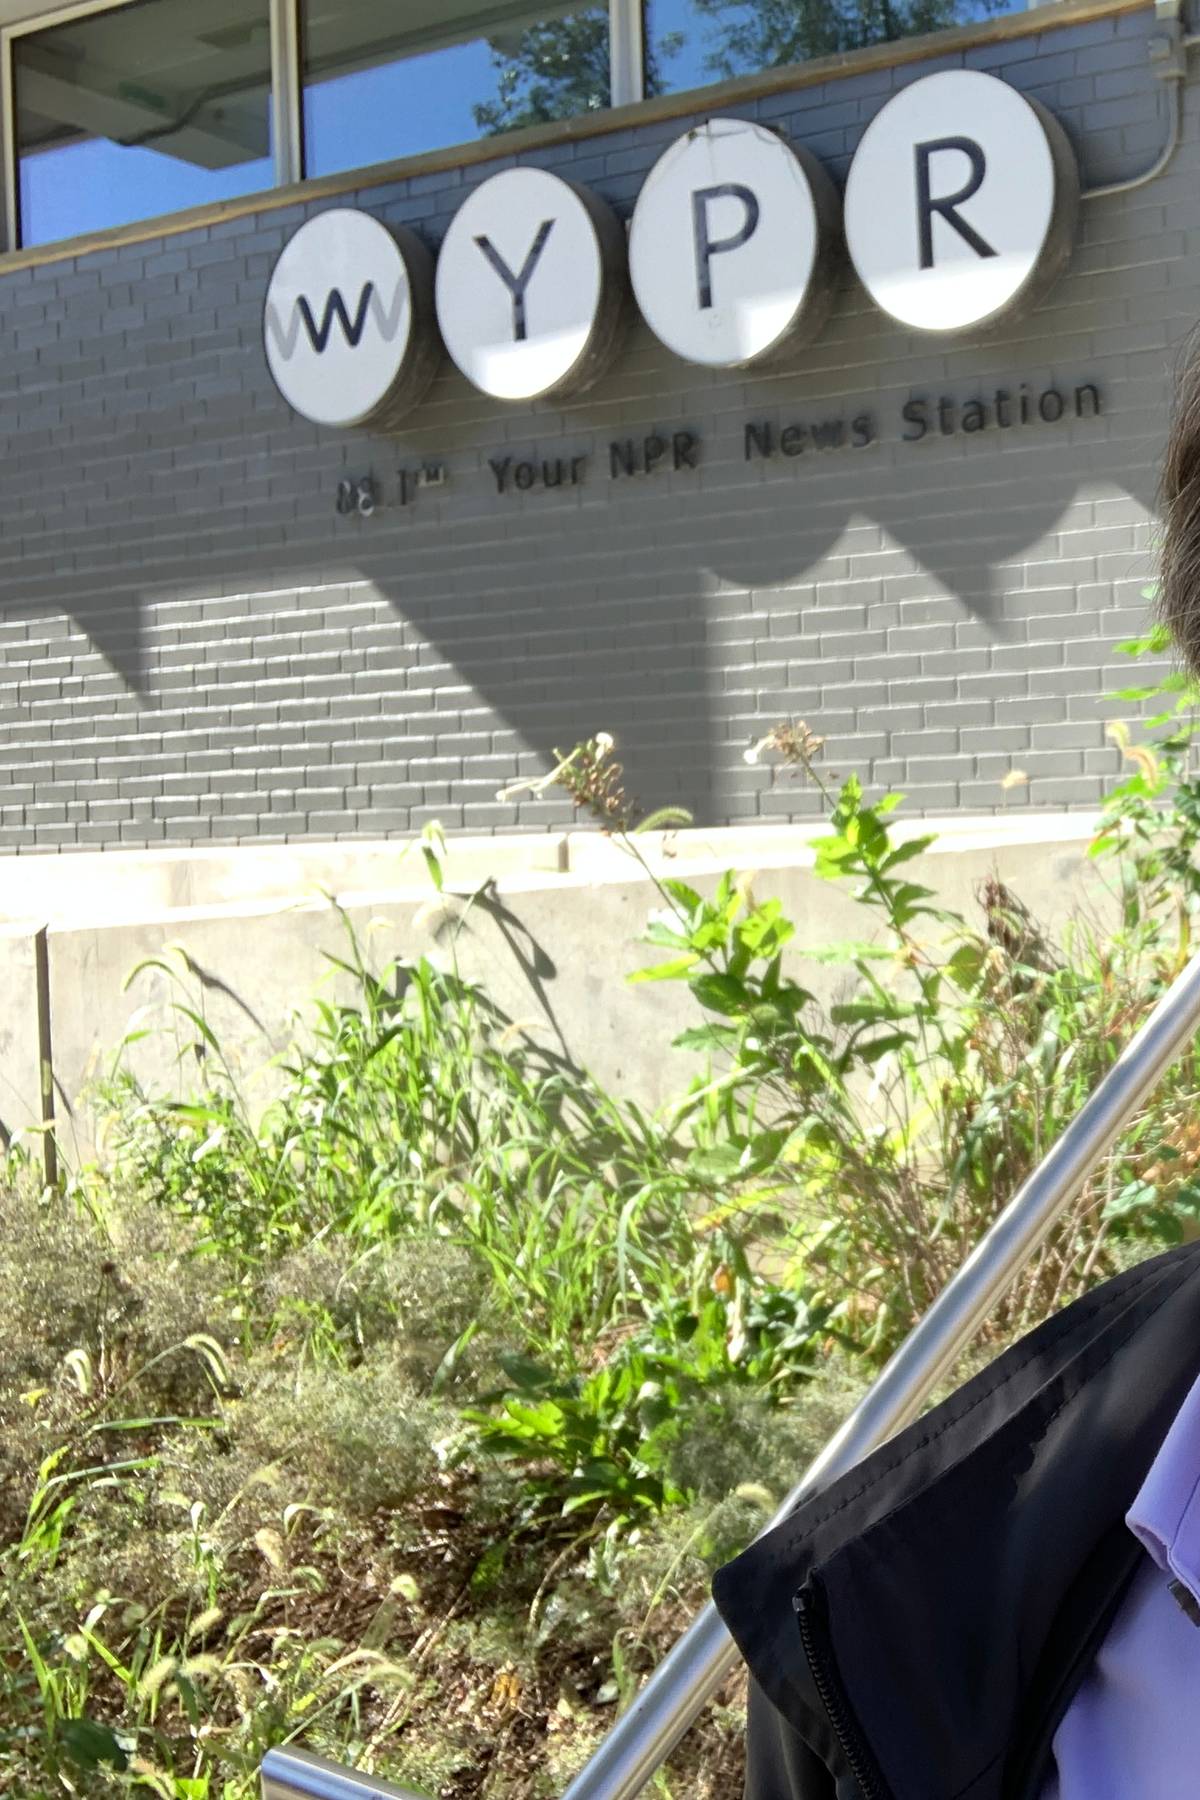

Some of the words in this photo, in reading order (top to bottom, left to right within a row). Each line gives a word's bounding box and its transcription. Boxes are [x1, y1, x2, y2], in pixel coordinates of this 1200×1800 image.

[488, 453, 587, 494] Your
[609, 430, 700, 480] NPR
[744, 413, 876, 462] News
[902, 381, 1102, 442] Station
